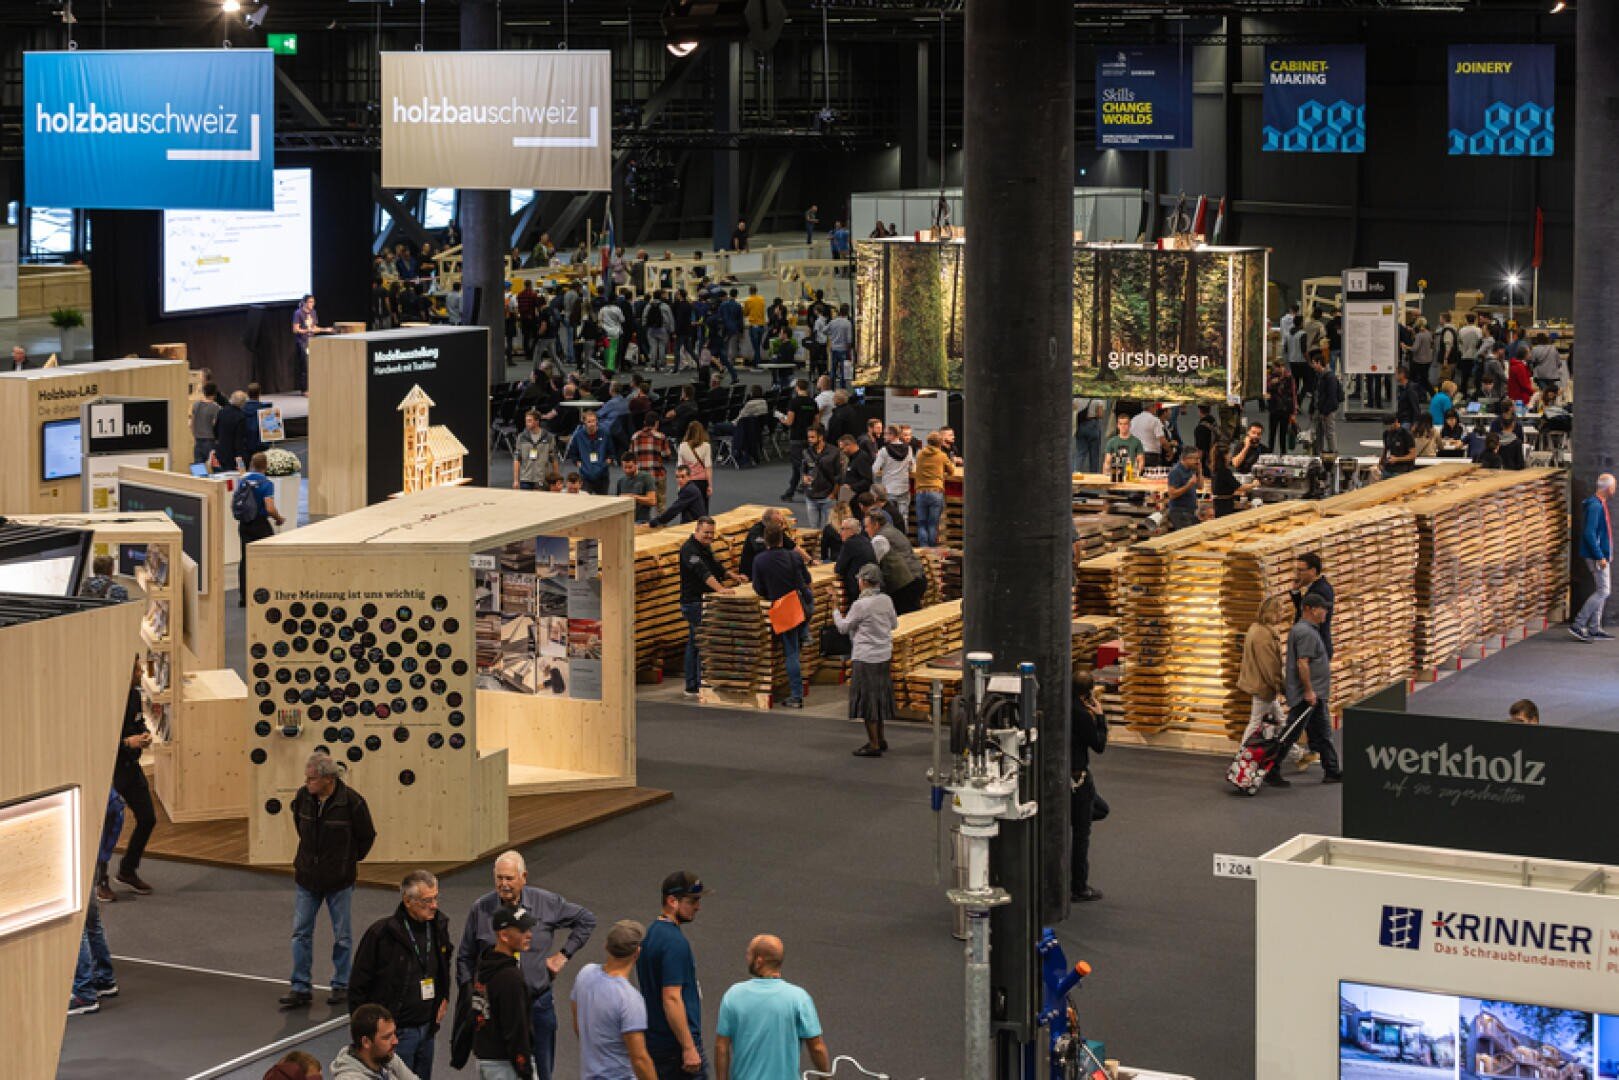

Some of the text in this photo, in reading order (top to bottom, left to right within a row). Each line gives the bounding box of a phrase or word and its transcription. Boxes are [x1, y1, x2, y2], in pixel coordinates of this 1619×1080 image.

[1270, 61, 1329, 73] CABINET-
[1455, 62, 1513, 74] JOINERY
[1270, 73, 1326, 85] MAKING
[1103, 87, 1135, 101] Skills
[392, 96, 578, 125] holzbauschweiz
[1103, 102, 1153, 113] CHANGE
[36, 102, 239, 134] holzbauschweiz
[1103, 114, 1153, 125] WORLDS
[1108, 347, 1209, 374] girsberger
[38, 384, 99, 401] Holzbau-LAB
[96, 418, 152, 436] 1.1 Info
[275, 588, 426, 601] Ihre Meinung ist uns wichtig
[1365, 742, 1546, 786] werkholz
[1432, 910, 1593, 955] KRINNER
[1433, 942, 1592, 971] Das Schraubfundament
